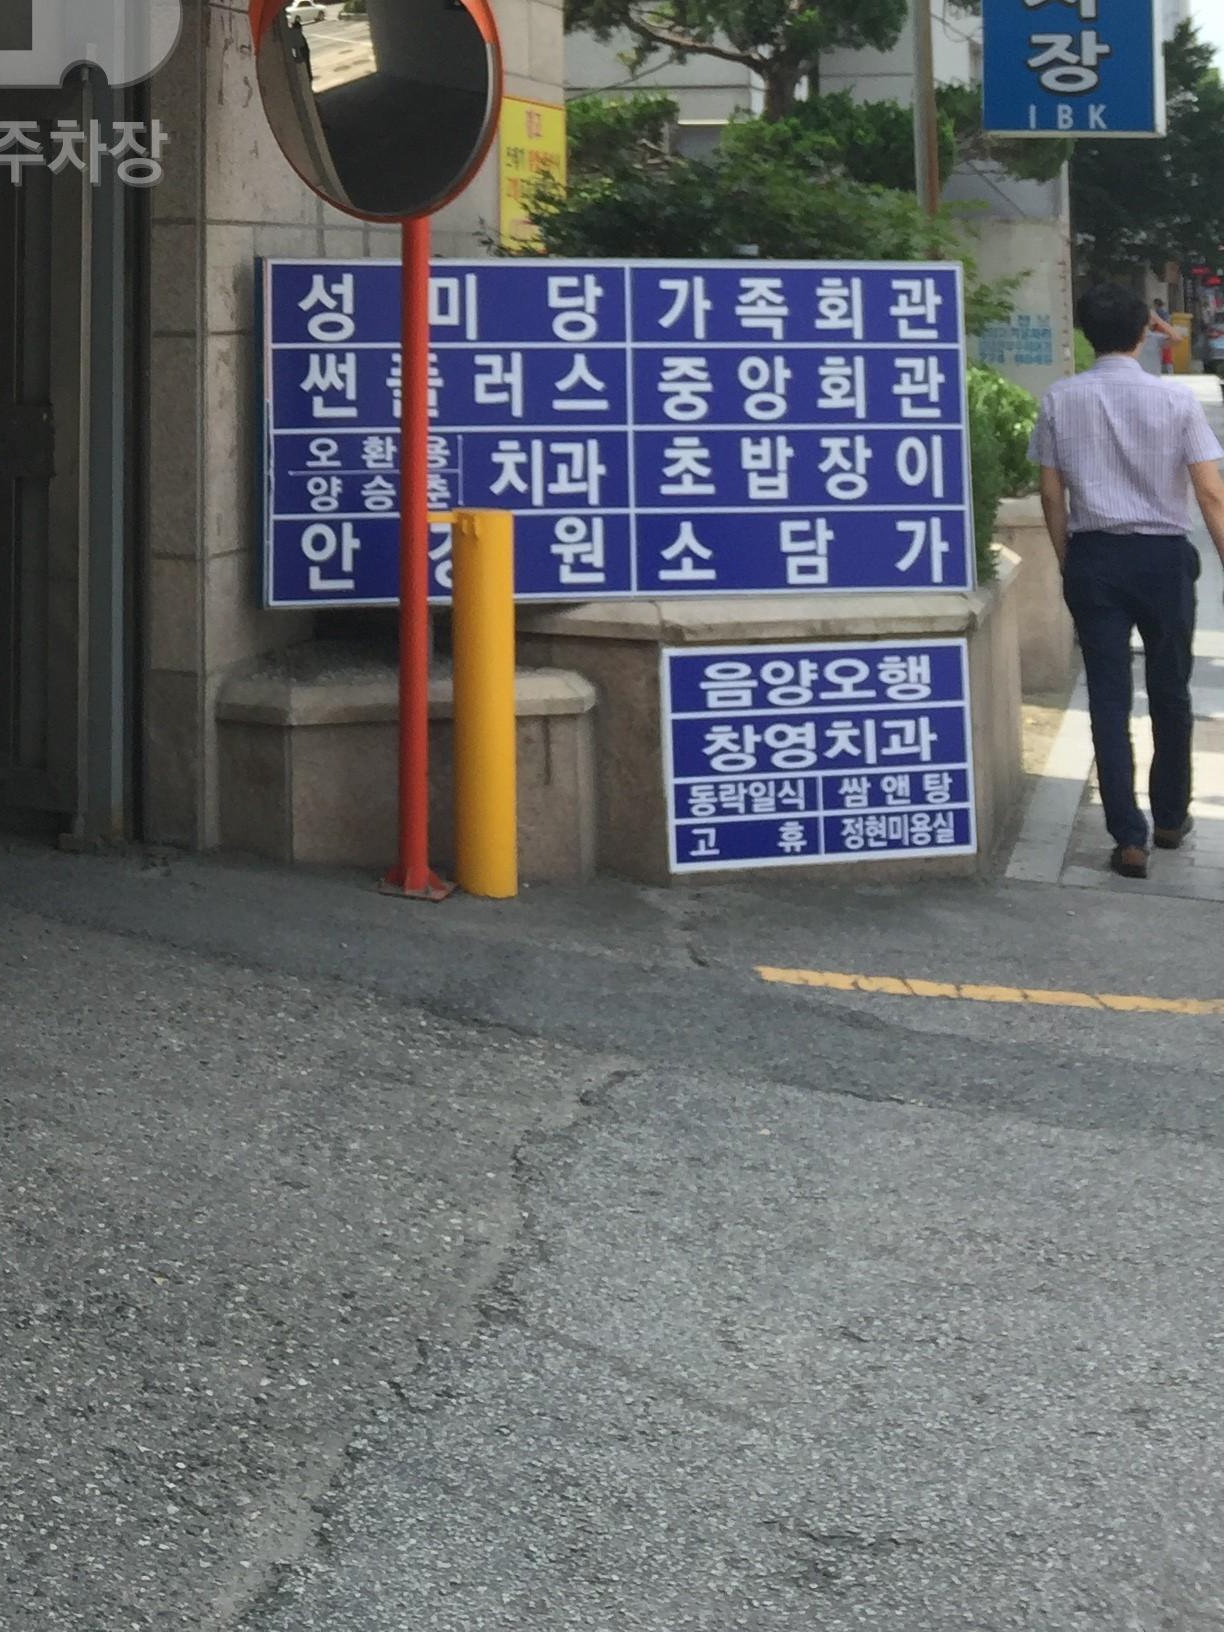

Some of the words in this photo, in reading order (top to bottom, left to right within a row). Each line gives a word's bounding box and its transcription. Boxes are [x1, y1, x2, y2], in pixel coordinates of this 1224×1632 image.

[659, 276, 942, 341] 가족회관
[658, 354, 944, 420] 중앙회관
[489, 438, 606, 506] 치과
[660, 434, 944, 499] 초밥장이
[660, 517, 949, 585] 소담가
[699, 654, 931, 708] 음양오행
[702, 716, 937, 772] 창영치과
[688, 779, 805, 817] 동락일식
[841, 811, 955, 850] 정현미용실
